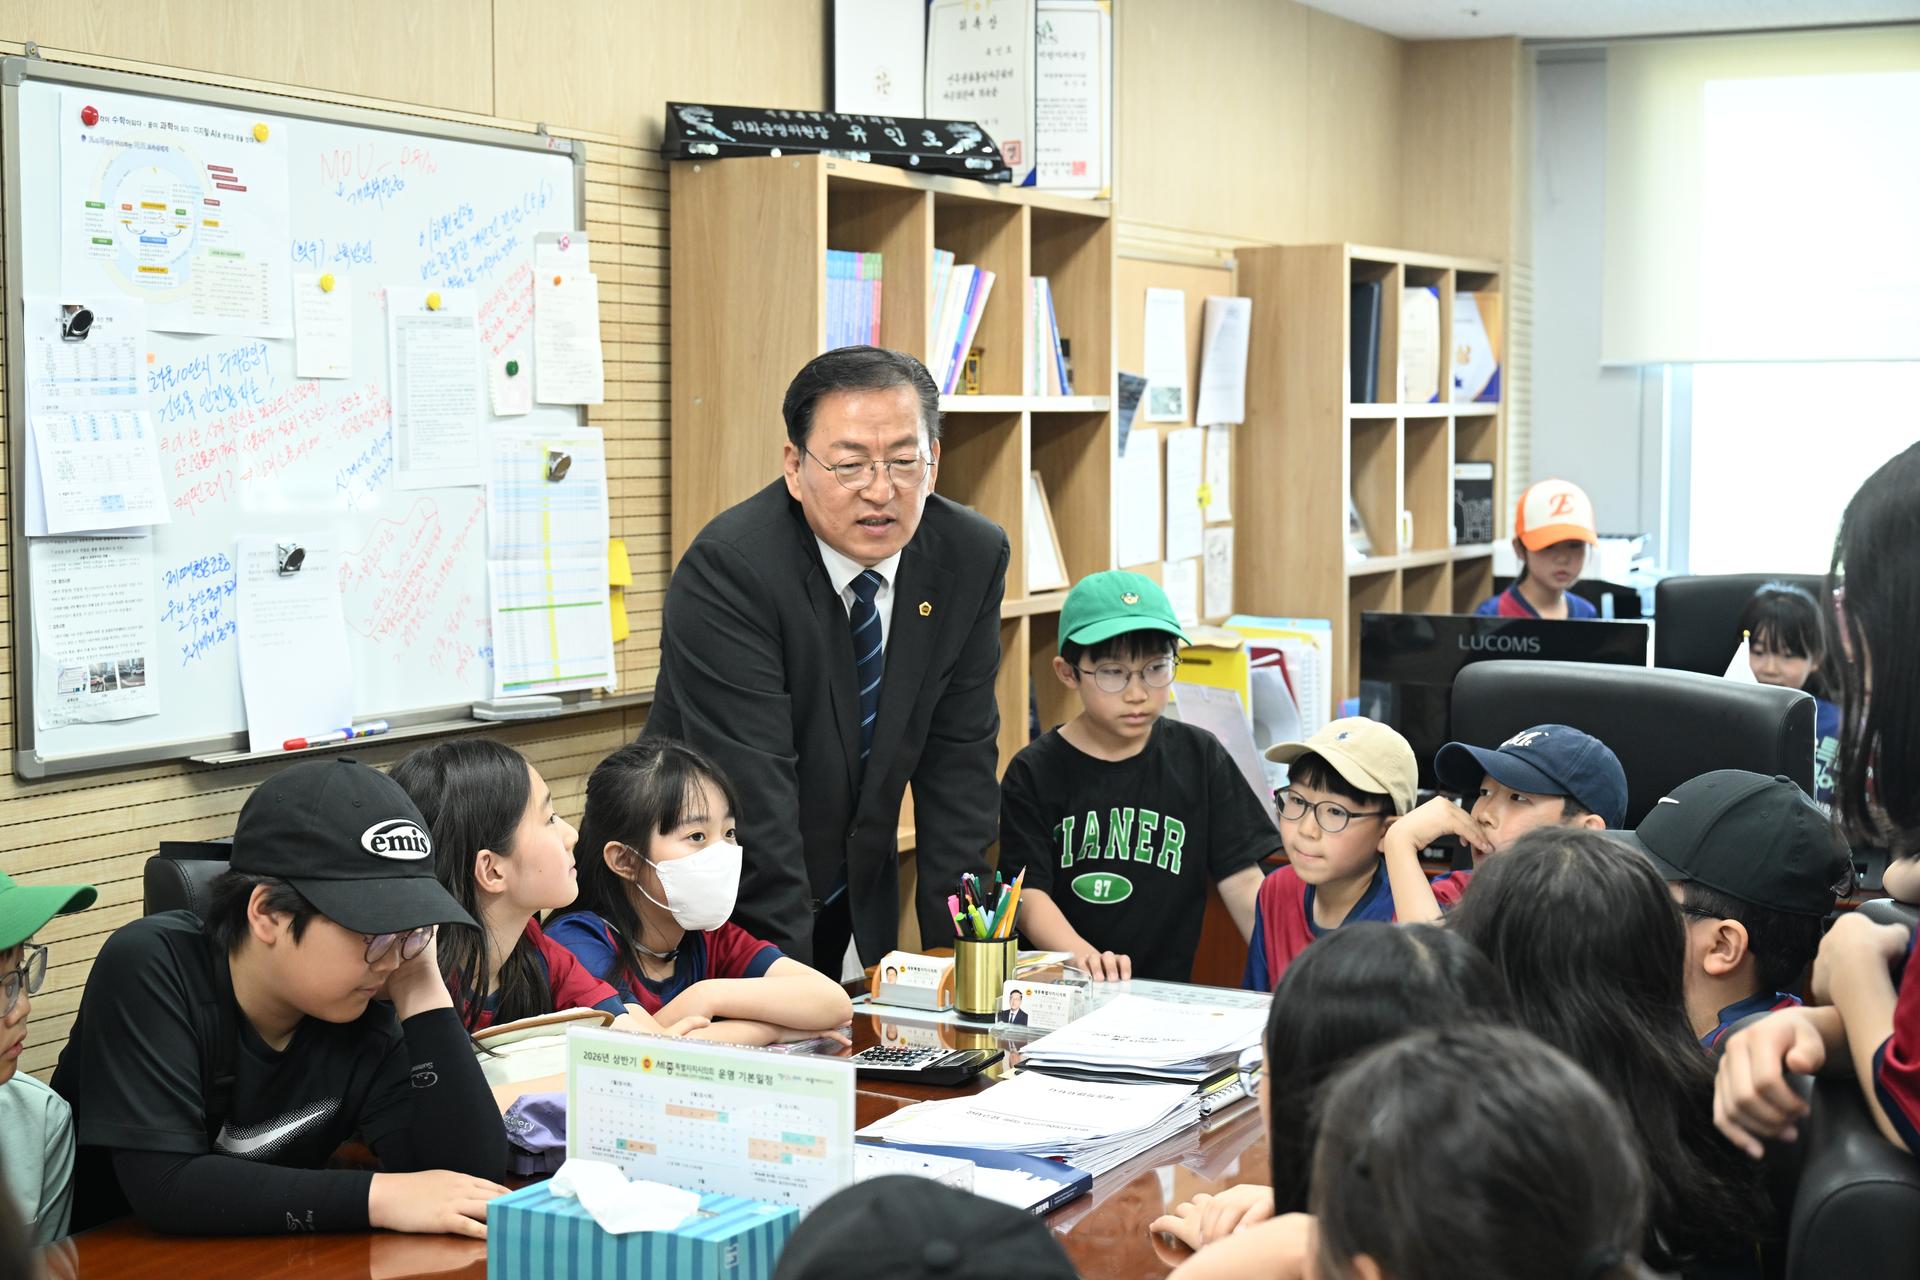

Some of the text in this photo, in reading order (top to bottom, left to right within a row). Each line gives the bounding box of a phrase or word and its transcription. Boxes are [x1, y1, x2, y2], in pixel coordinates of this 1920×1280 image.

[1457, 633, 1541, 653] LUCOMS
[370, 827, 429, 854] emis
[1053, 807, 1186, 875] IANER
[583, 1050, 609, 1064] 2026년
[612, 1053, 637, 1068] 상반기
[718, 1068, 735, 1081] 운영
[738, 1071, 774, 1086] 기본일정
